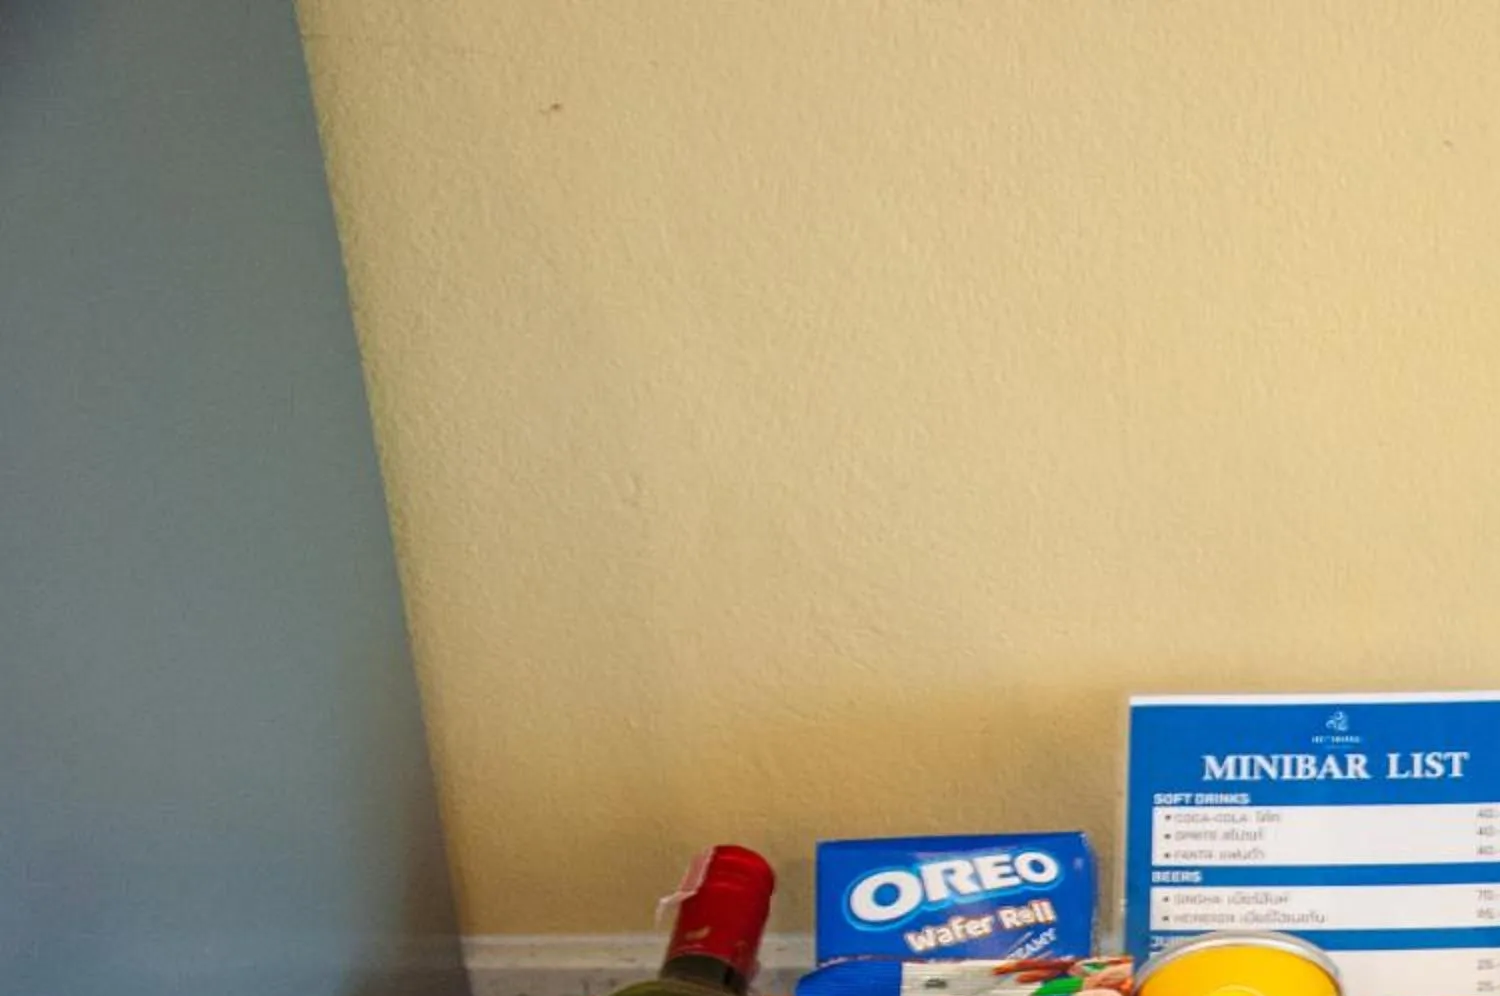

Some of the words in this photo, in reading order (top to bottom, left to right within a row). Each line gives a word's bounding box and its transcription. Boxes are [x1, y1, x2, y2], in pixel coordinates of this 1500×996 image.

[1202, 753, 1371, 782] MINIBAR
[1387, 751, 1470, 779] LIST
[1153, 793, 1192, 805] SOFT
[1195, 793, 1250, 805] DRINKS
[849, 851, 1059, 922] OREO
[1151, 871, 1202, 883] BEERS
[904, 912, 995, 951] Wafer
[999, 899, 1057, 931] Roll
